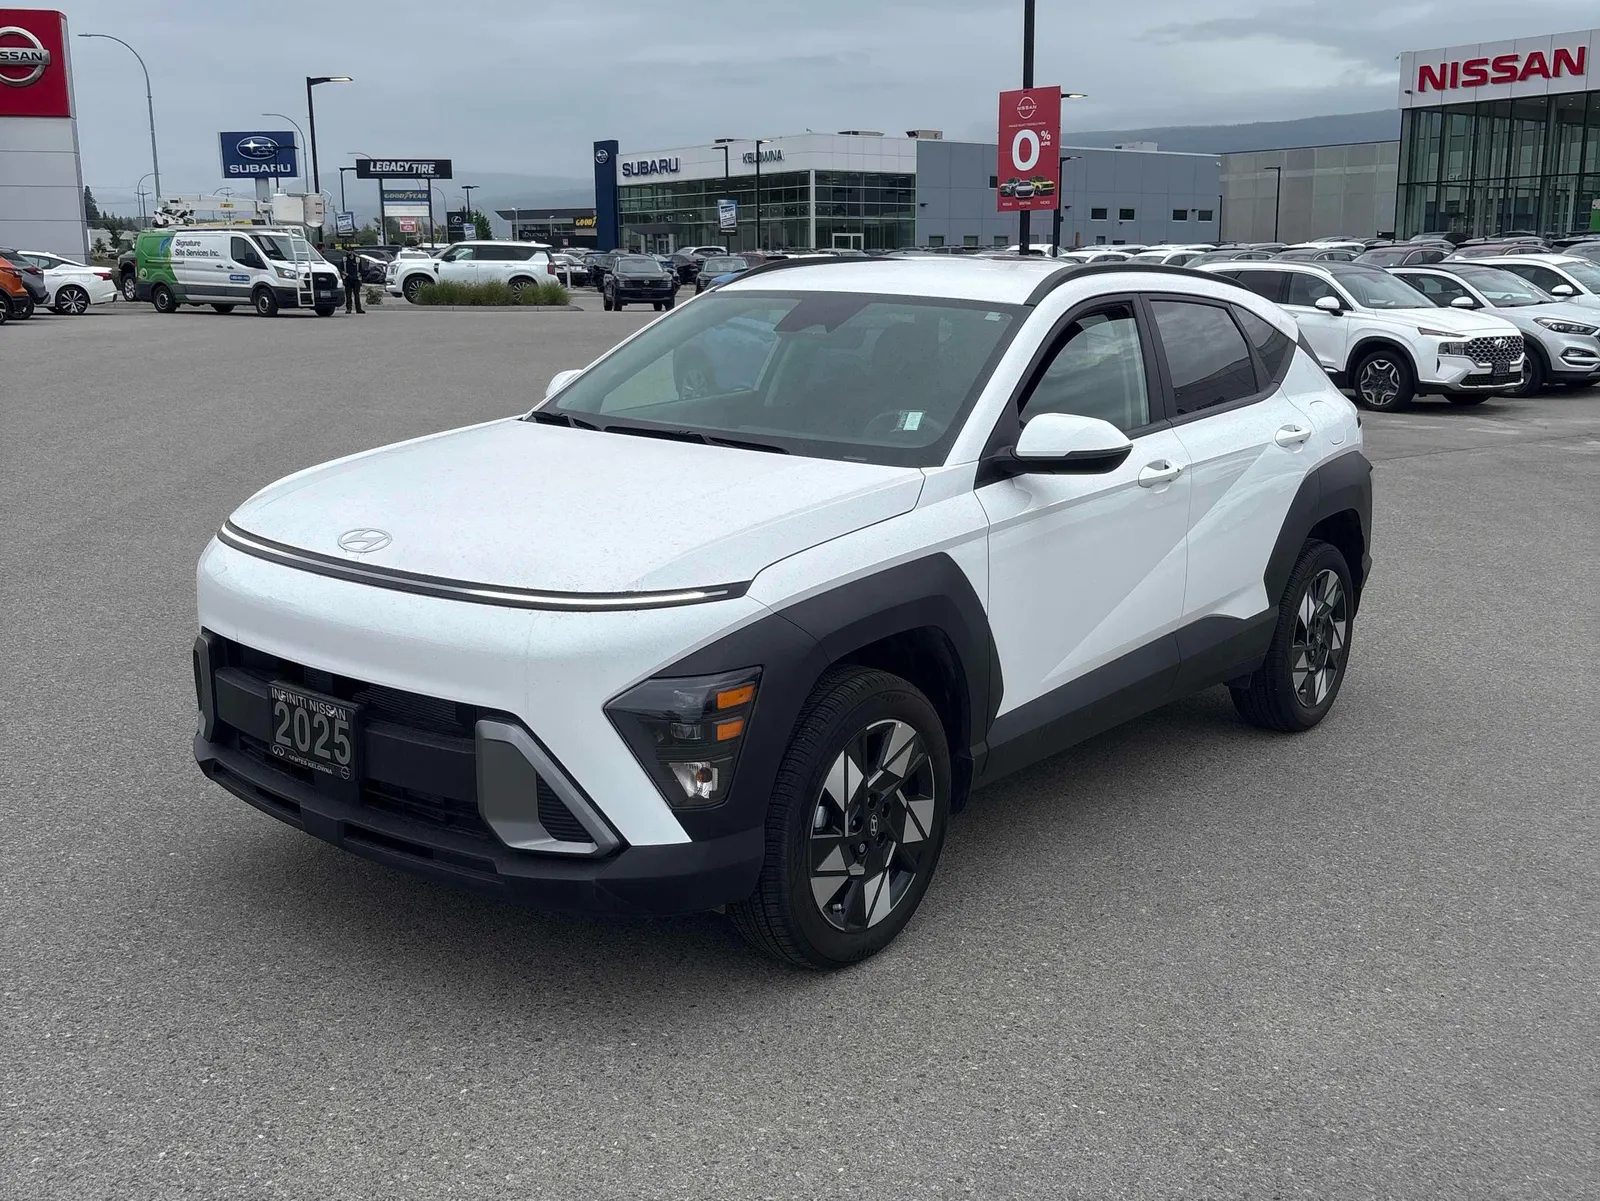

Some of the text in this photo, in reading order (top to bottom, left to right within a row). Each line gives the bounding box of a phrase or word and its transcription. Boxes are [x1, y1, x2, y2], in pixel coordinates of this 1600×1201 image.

[1418, 46, 1586, 92] NISSAN
[229, 163, 291, 173] SUBARU
[370, 161, 436, 174] LEGACY TIRE
[622, 157, 680, 177] SUBARU
[384, 191, 428, 199] GOODYEAR
[175, 239, 201, 248] Signature
[174, 249, 220, 257] Site Services Inc.
[271, 687, 346, 721] INFINITI NISSAN
[274, 701, 352, 766] 2025
